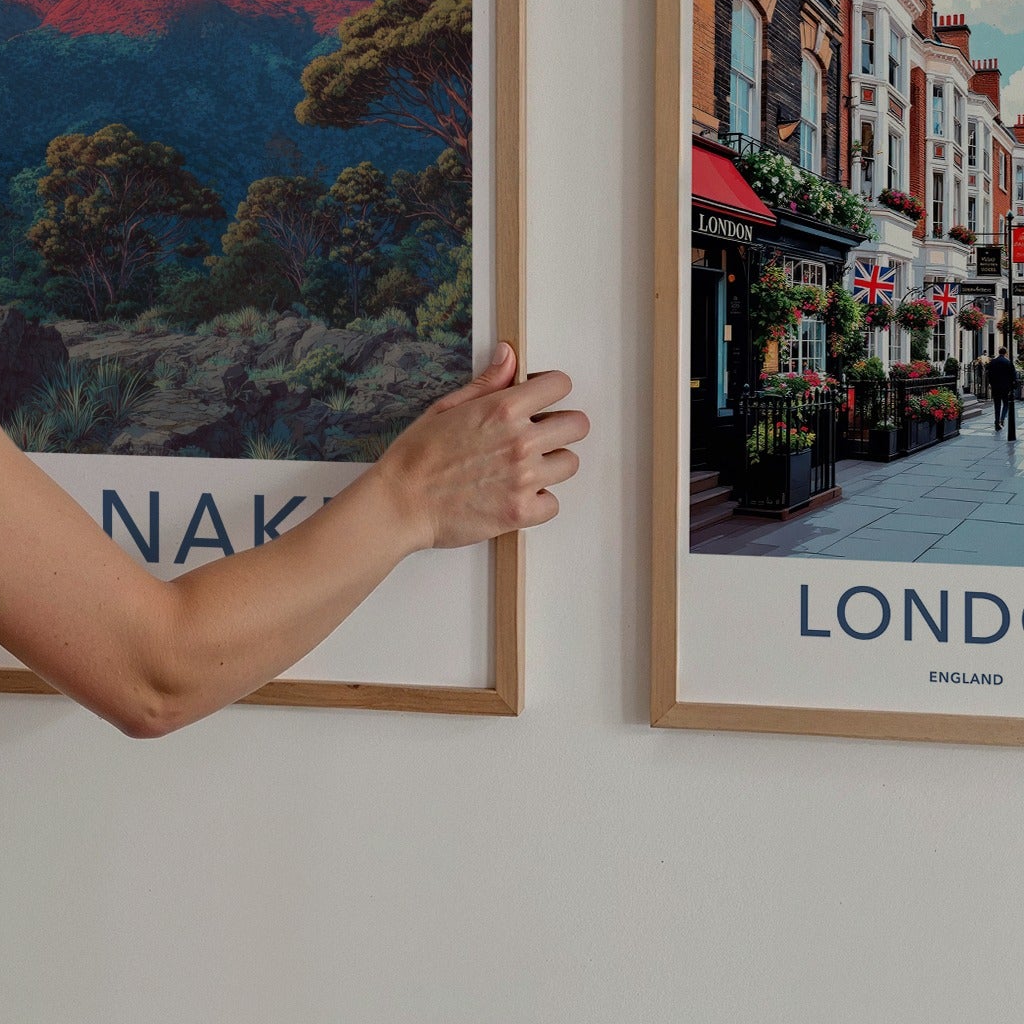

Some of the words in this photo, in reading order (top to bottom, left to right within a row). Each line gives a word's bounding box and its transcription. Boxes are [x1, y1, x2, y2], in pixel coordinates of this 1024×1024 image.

[698, 213, 753, 242] LONDON
[102, 488, 334, 564] NAK
[800, 584, 1024, 644] LOND
[929, 670, 1004, 686] ENGLAND
